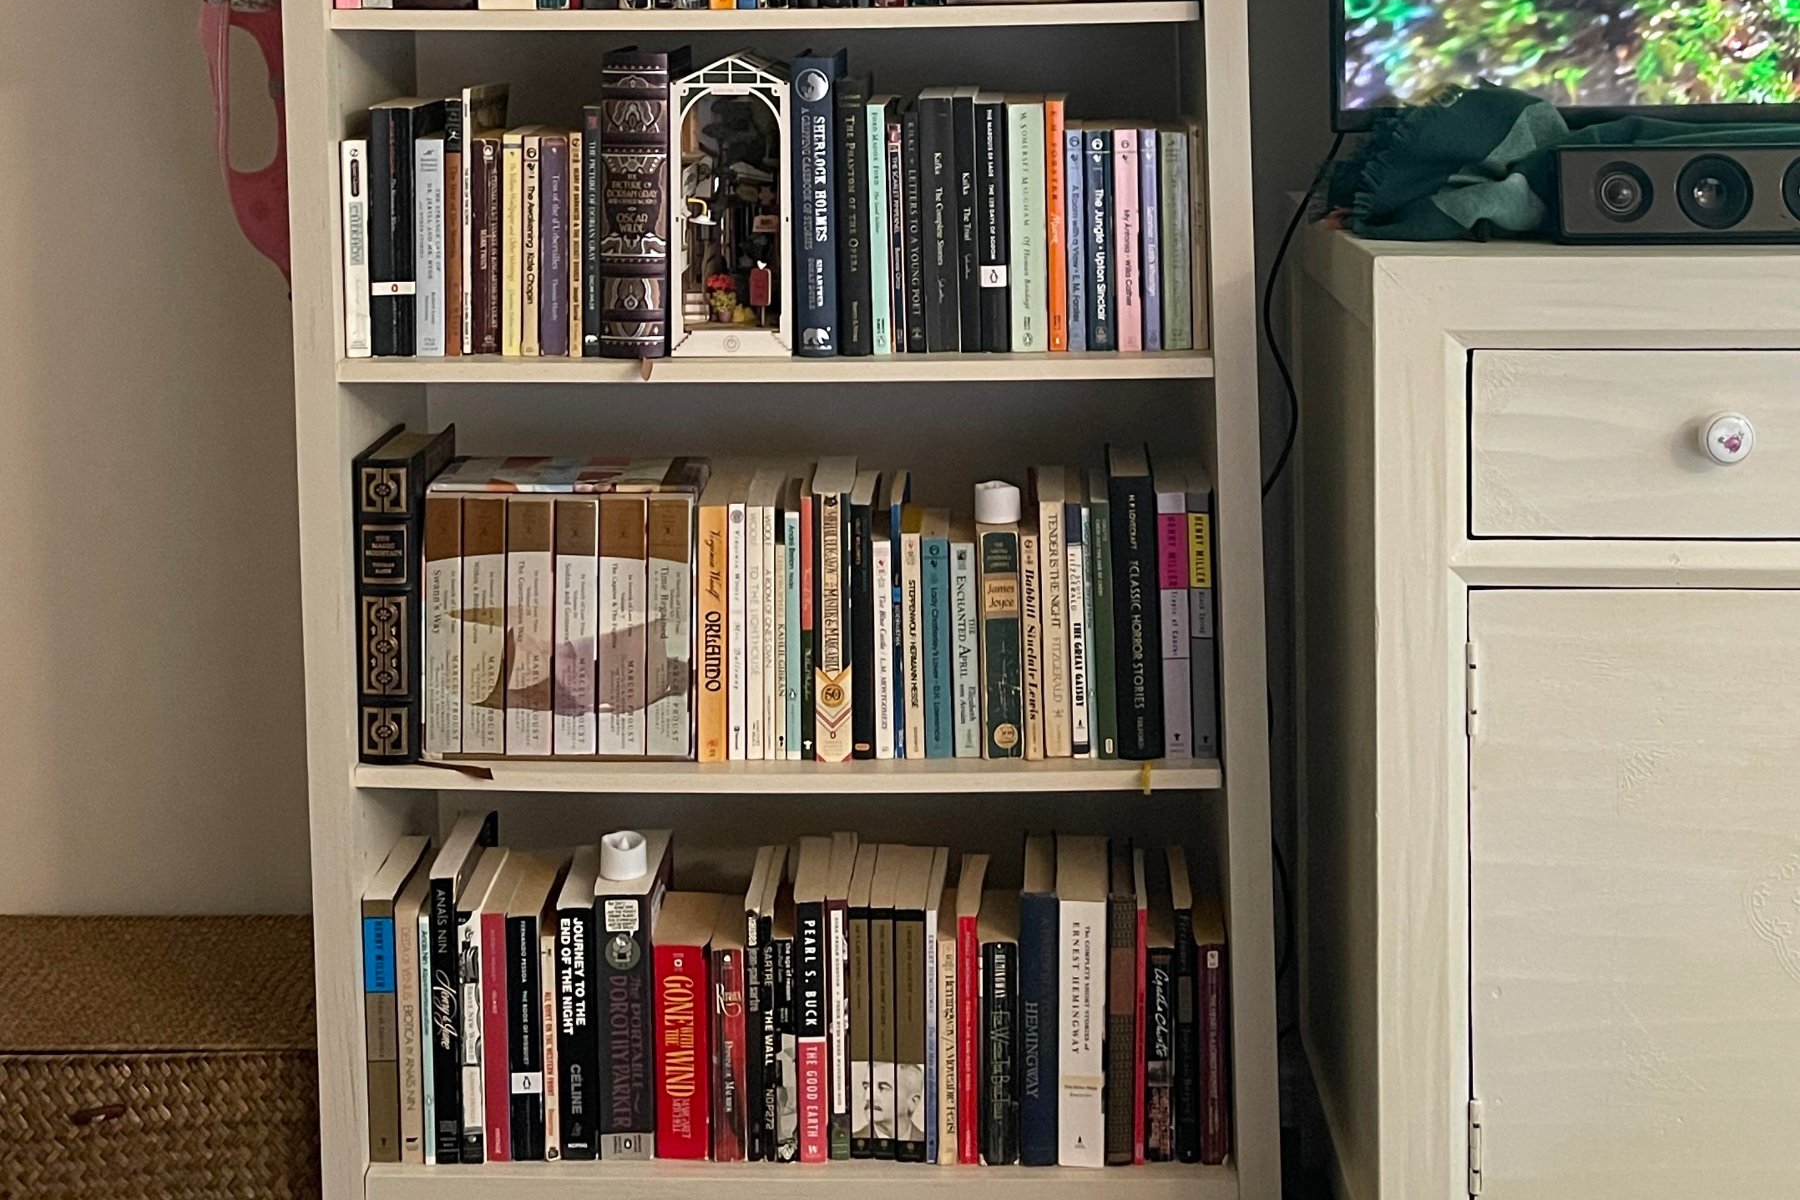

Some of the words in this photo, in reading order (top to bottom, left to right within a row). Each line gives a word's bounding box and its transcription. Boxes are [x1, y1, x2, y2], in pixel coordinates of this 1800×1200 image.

[845, 115, 856, 138] THE
[813, 116, 826, 185] SHERLOCK
[933, 152, 942, 175] Kafka
[551, 175, 560, 189] Tess
[846, 142, 857, 193] PHANTOM
[962, 172, 970, 195] Kafka
[527, 185, 535, 201] The
[551, 190, 560, 203] of
[848, 198, 856, 210] OF
[907, 169, 919, 215] LETTERS
[935, 187, 944, 202] The
[1095, 189, 1104, 207] The
[526, 202, 535, 248] Awakening
[551, 204, 560, 217] the
[814, 191, 828, 242] HOLMES
[848, 214, 857, 234] THE
[910, 218, 919, 233] TO
[934, 203, 944, 238] Complete
[963, 207, 971, 221] The
[1093, 209, 1103, 244] Jungle
[910, 236, 920, 244] A
[963, 222, 971, 241] Trial
[527, 252, 536, 271] Kate
[848, 238, 859, 272] OPERA
[911, 246, 921, 285] YOUNG
[936, 240, 945, 266] Stories
[1094, 251, 1105, 281] Upton
[525, 273, 536, 305] Chopin
[912, 289, 921, 316] POET
[1096, 283, 1107, 320] Sinclair
[1049, 514, 1060, 556] TENDER
[659, 566, 669, 591] Time
[750, 567, 759, 580] TO
[1050, 557, 1060, 568] IS
[432, 570, 442, 611] Swann's
[750, 583, 760, 605] THE
[987, 584, 1014, 595] James
[1025, 569, 1035, 619] Babbitt
[1050, 570, 1060, 595] THE
[1128, 565, 1141, 611] CLASSIC
[658, 594, 669, 639] Regained
[957, 575, 968, 642] ENCHANTED
[987, 597, 1014, 609] Joyce
[1051, 598, 1061, 628] NIGHT
[431, 614, 442, 635] Way
[1074, 622, 1082, 640] THE
[1131, 615, 1144, 660] HORROR
[705, 611, 722, 692] ORLANDO
[751, 609, 761, 676] LIGHTHOUSE
[777, 624, 785, 658] KAHLIL
[1026, 625, 1037, 679] Sinclair
[1074, 642, 1084, 671] GREAT
[959, 644, 971, 678] APRIL
[1052, 636, 1064, 703] FITZGERALD
[1075, 673, 1084, 707] GATSBY
[1133, 662, 1145, 709] STORIES
[1028, 683, 1039, 721] Lewis
[436, 889, 449, 926] ANAÏS
[437, 929, 448, 954] NIN
[560, 917, 571, 944] END
[804, 920, 816, 963] PEARL
[1072, 922, 1080, 970] ERNEST
[561, 947, 572, 965] OF
[572, 917, 585, 977] JOURNEY
[562, 967, 572, 993] THE
[764, 946, 773, 987] SARTRE
[805, 970, 817, 983] S.
[574, 980, 585, 997] TO
[663, 975, 694, 1027] GONE
[562, 996, 573, 1035] NIGHT
[575, 1000, 586, 1026] THE
[609, 975, 629, 1065] DOROTHY
[764, 1010, 773, 1032] THE
[805, 991, 818, 1027] BUCK
[1071, 976, 1080, 1055] HEMINGWAY
[665, 1029, 680, 1046] THE
[681, 1027, 693, 1048] WITH
[764, 1034, 774, 1066] WALL
[1024, 1001, 1038, 1099] HEMINGWAY
[806, 1046, 818, 1067] THE
[570, 1063, 585, 1114] CÉLINE
[666, 1049, 695, 1097] WIND
[806, 1070, 818, 1100] GOOD
[612, 1065, 631, 1128] PARKER
[807, 1105, 819, 1137] EARTH
